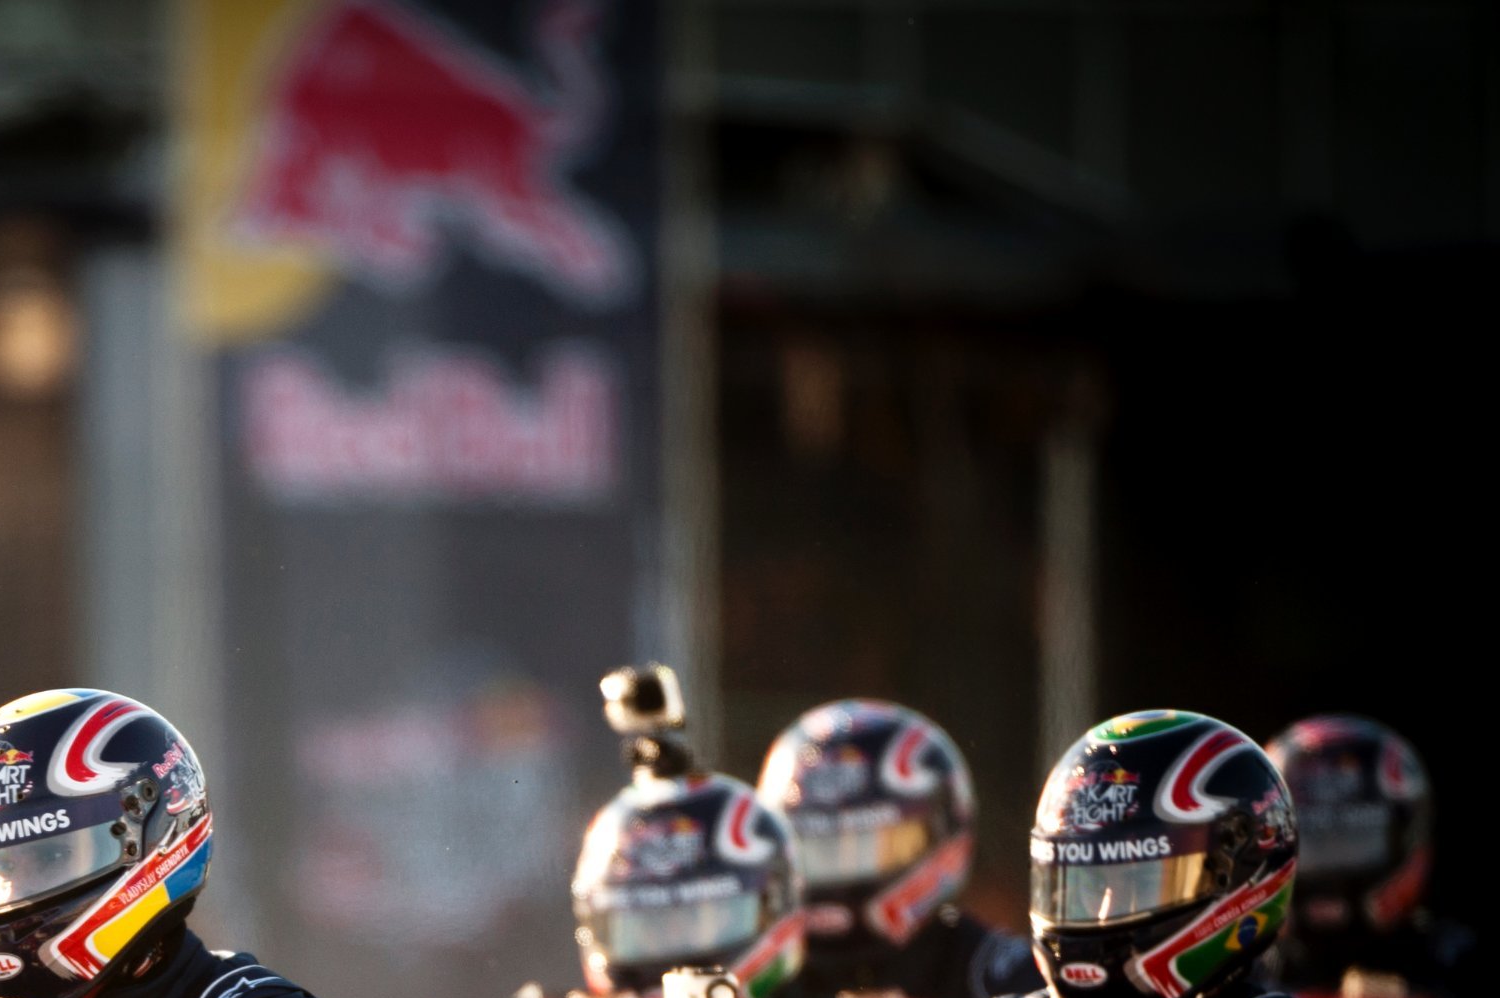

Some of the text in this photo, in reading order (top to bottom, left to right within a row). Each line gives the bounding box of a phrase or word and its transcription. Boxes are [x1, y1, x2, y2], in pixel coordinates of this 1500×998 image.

[1088, 784, 1138, 803] KART
[1075, 802, 1129, 826] FIGHT
[1056, 842, 1094, 862] YOU
[1097, 836, 1172, 861] WINGS
[1064, 967, 1103, 980] BELL
